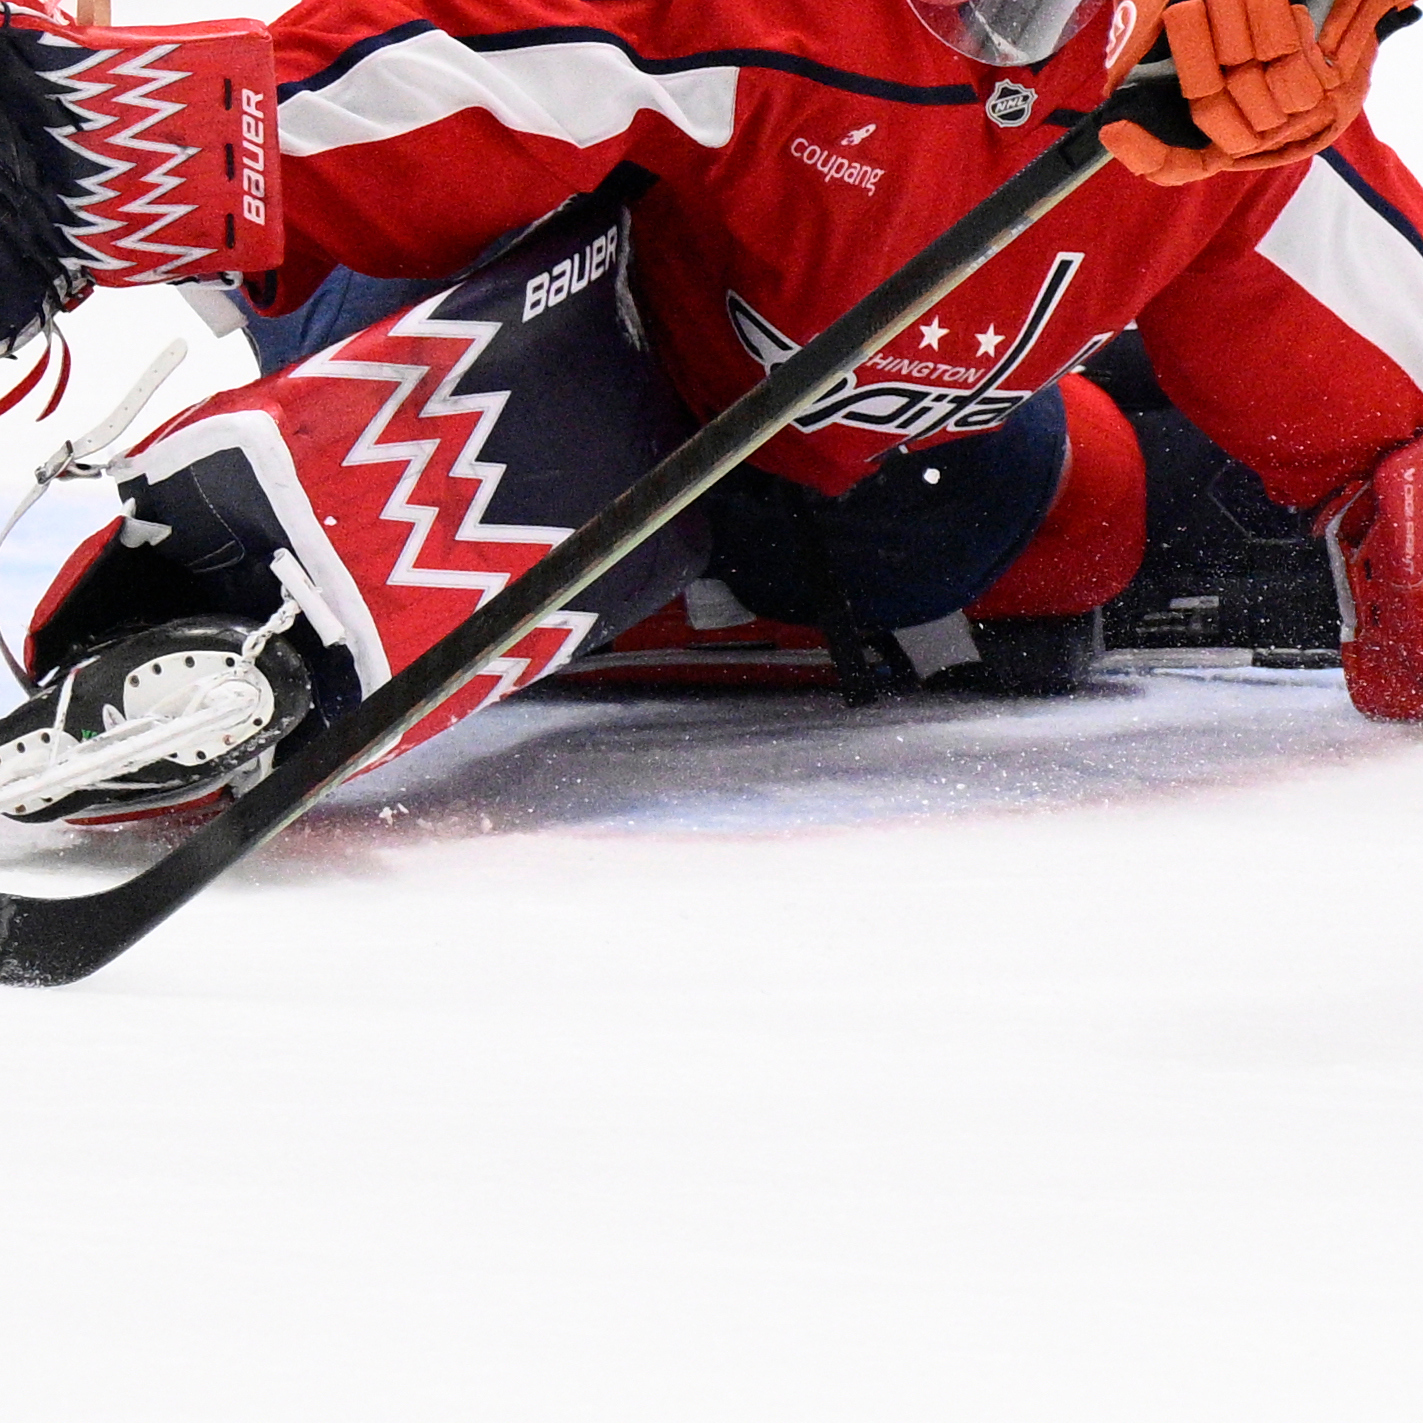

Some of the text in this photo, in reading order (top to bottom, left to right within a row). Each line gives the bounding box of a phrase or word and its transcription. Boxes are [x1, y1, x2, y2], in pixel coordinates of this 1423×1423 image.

[994, 95, 1027, 114] NHL
[241, 87, 266, 226] BAUER
[790, 137, 885, 197] coupang
[521, 225, 618, 324] BAUER
[865, 352, 986, 384] HINGTON
